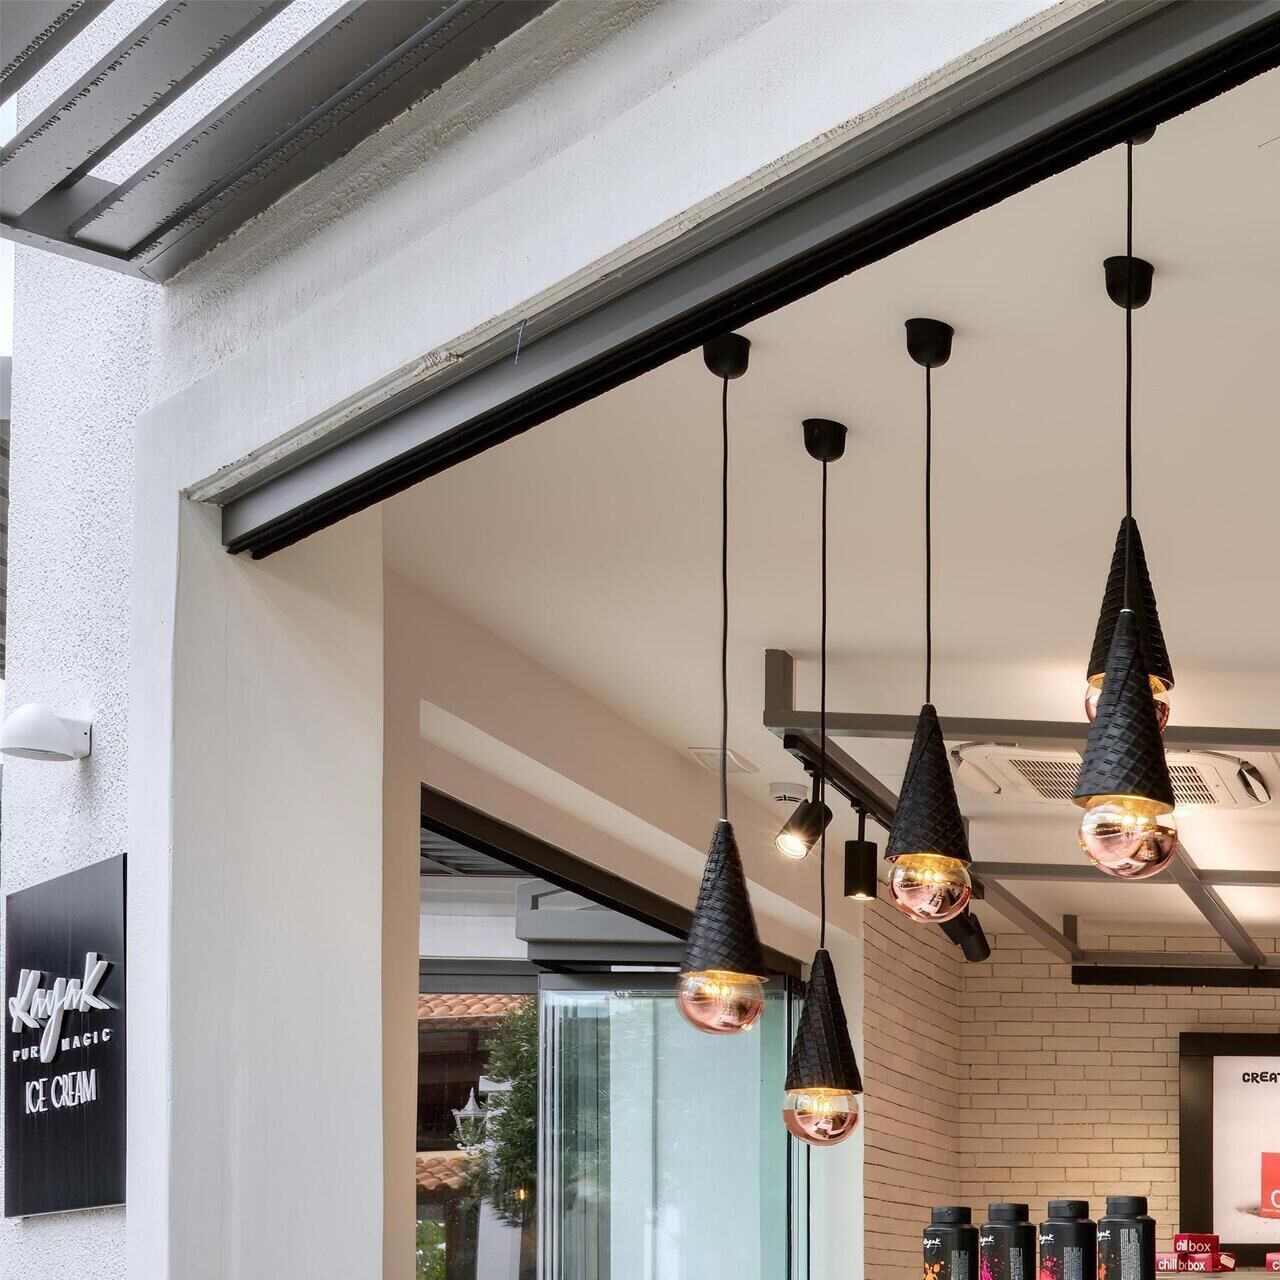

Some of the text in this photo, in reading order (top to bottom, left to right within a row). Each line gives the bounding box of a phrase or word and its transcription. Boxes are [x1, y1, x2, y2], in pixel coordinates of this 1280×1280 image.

[9, 952, 111, 1063] Kayak
[61, 1028, 112, 1051] MAGIC
[25, 1069, 97, 1114] ICE CREAM
[1189, 1240, 1211, 1252] box
